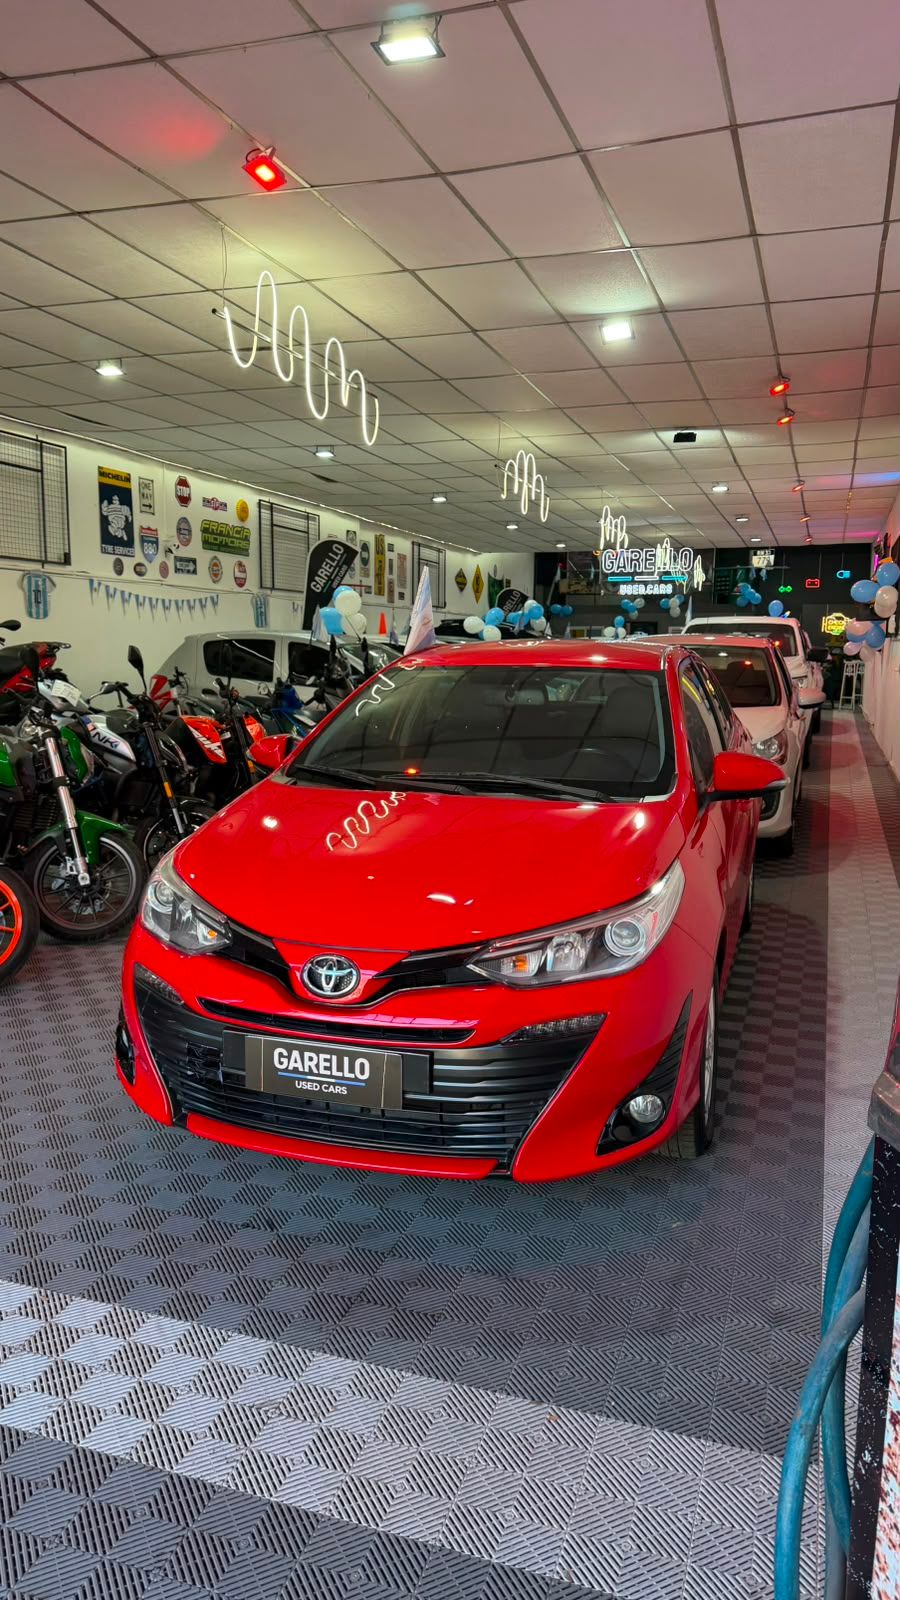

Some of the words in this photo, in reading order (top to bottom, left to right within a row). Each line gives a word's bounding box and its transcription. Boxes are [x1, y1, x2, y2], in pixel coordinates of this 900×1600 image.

[99, 470, 131, 483] MICHELIN
[141, 481, 151, 490] ONE
[177, 486, 190, 497] STOP
[141, 492, 152, 501] WAY
[202, 532, 250, 549] MOTORS
[102, 544, 114, 554] TYRE
[602, 547, 694, 573] GARELLO
[310, 543, 344, 593] GARELLO
[619, 584, 645, 595] USED
[646, 583, 673, 595] CARS
[33, 589, 42, 604] 10
[273, 1047, 370, 1080] GARELLO
[295, 1080, 320, 1091] USED
[321, 1084, 348, 1095] CARS
